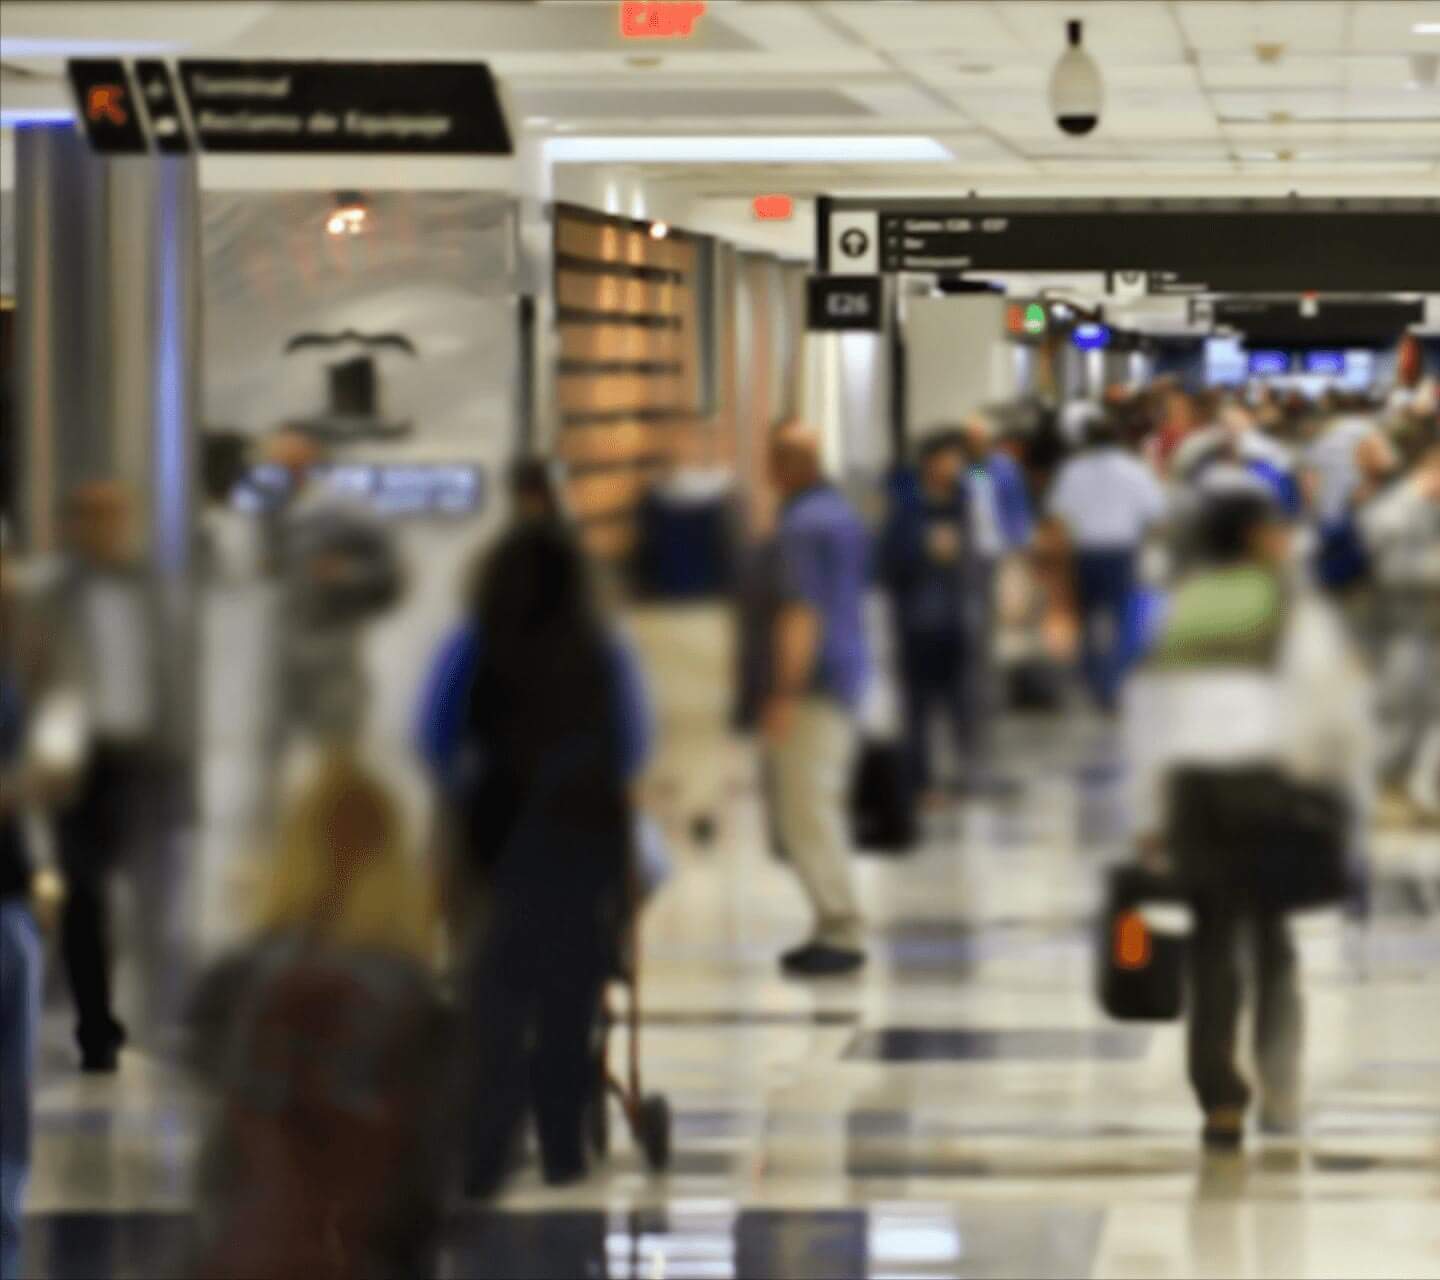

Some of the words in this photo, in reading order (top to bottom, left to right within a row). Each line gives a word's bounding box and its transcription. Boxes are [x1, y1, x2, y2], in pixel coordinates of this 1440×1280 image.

[191, 74, 291, 98] Terminal
[200, 110, 303, 135] Reclamo
[307, 112, 340, 134] de
[343, 110, 452, 137] Equipaje
[826, 292, 870, 317] E26
